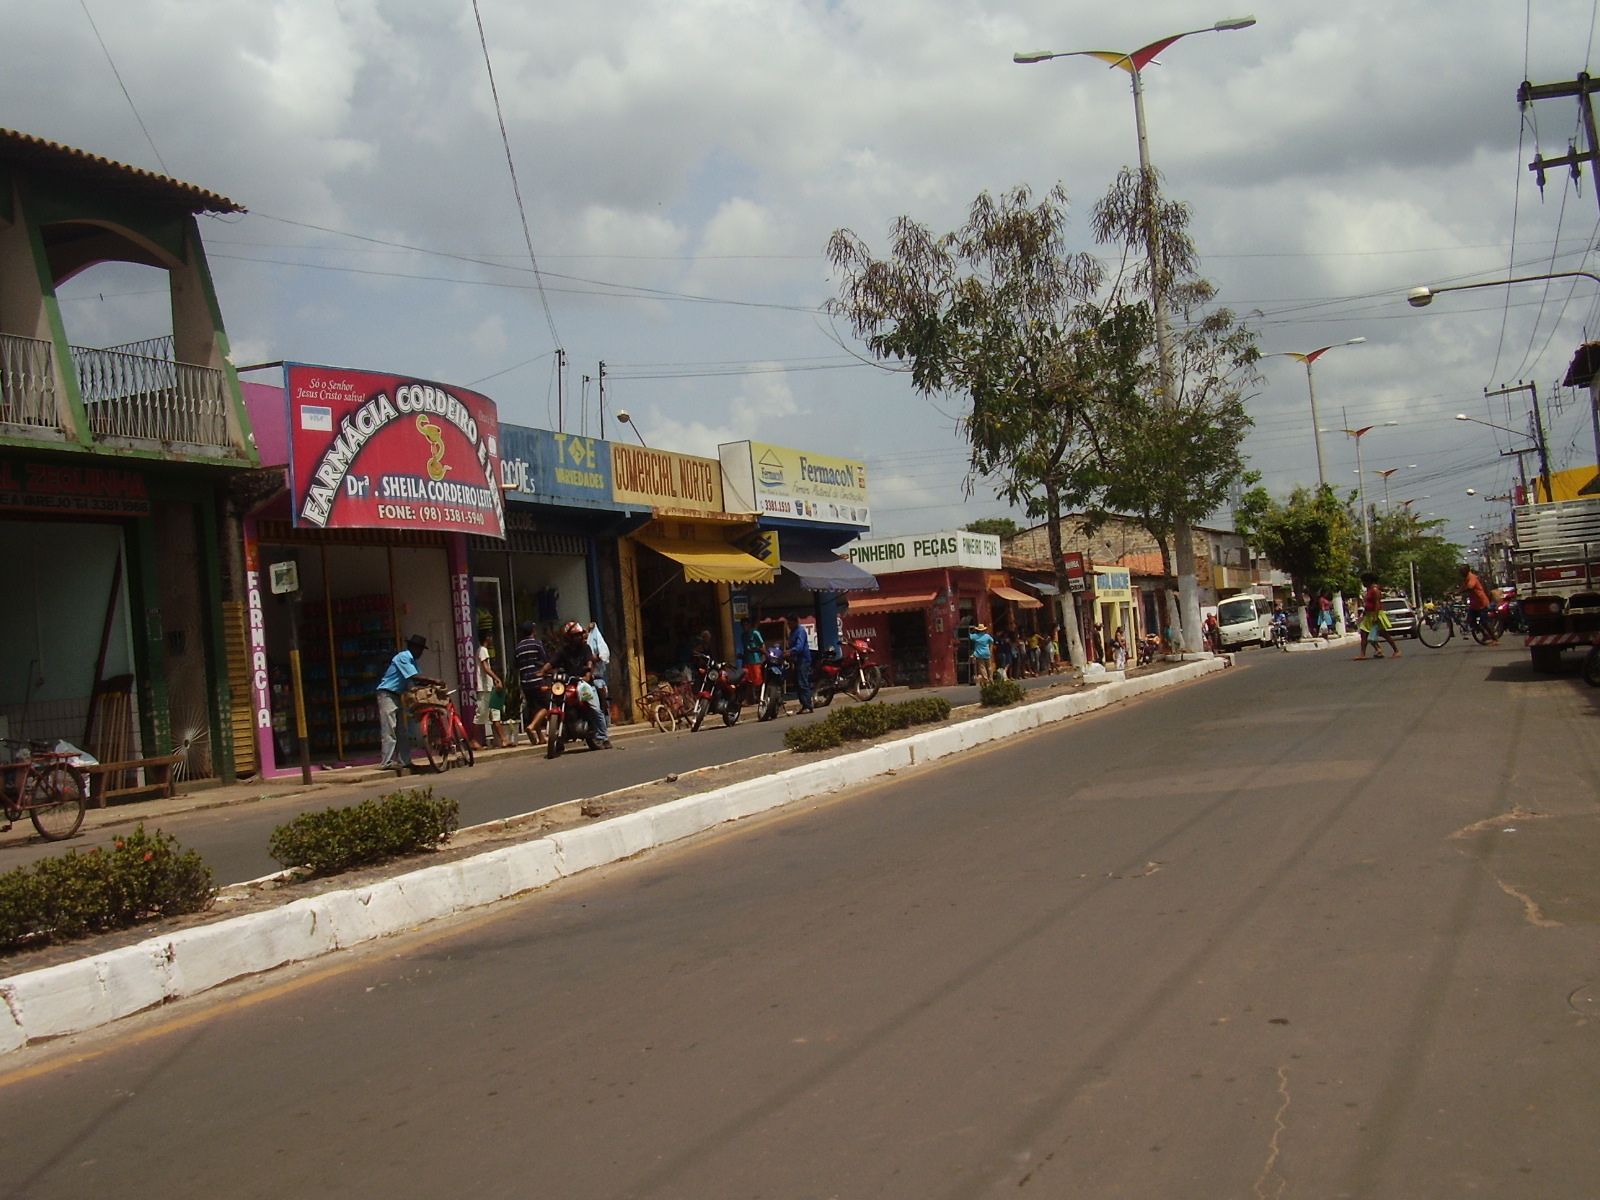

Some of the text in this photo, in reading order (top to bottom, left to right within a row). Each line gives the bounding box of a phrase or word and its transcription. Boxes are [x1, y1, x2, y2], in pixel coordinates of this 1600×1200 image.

[297, 388, 366, 403] Jesus Cristo salva!
[310, 379, 321, 389] Só
[328, 380, 354, 391] Senhor
[301, 394, 398, 528] FARMÁCIA
[396, 384, 478, 445] CORDEIRO
[26, 463, 147, 497] ZEQUINHA
[555, 467, 605, 490] VARIEDADES
[22, 495, 71, 508] VAREJO
[382, 476, 427, 500] SHEILA
[427, 481, 478, 507] CORDEIRO
[378, 504, 416, 520] FONE:
[419, 506, 441, 523] (98)
[850, 537, 957, 564] PINHEIRO PEÇAS
[962, 537, 982, 554] PINHEIRO
[459, 573, 478, 706] FARMÁCIA
[846, 627, 877, 639] YAMAHA
[246, 571, 271, 728] FARMÁCIA
